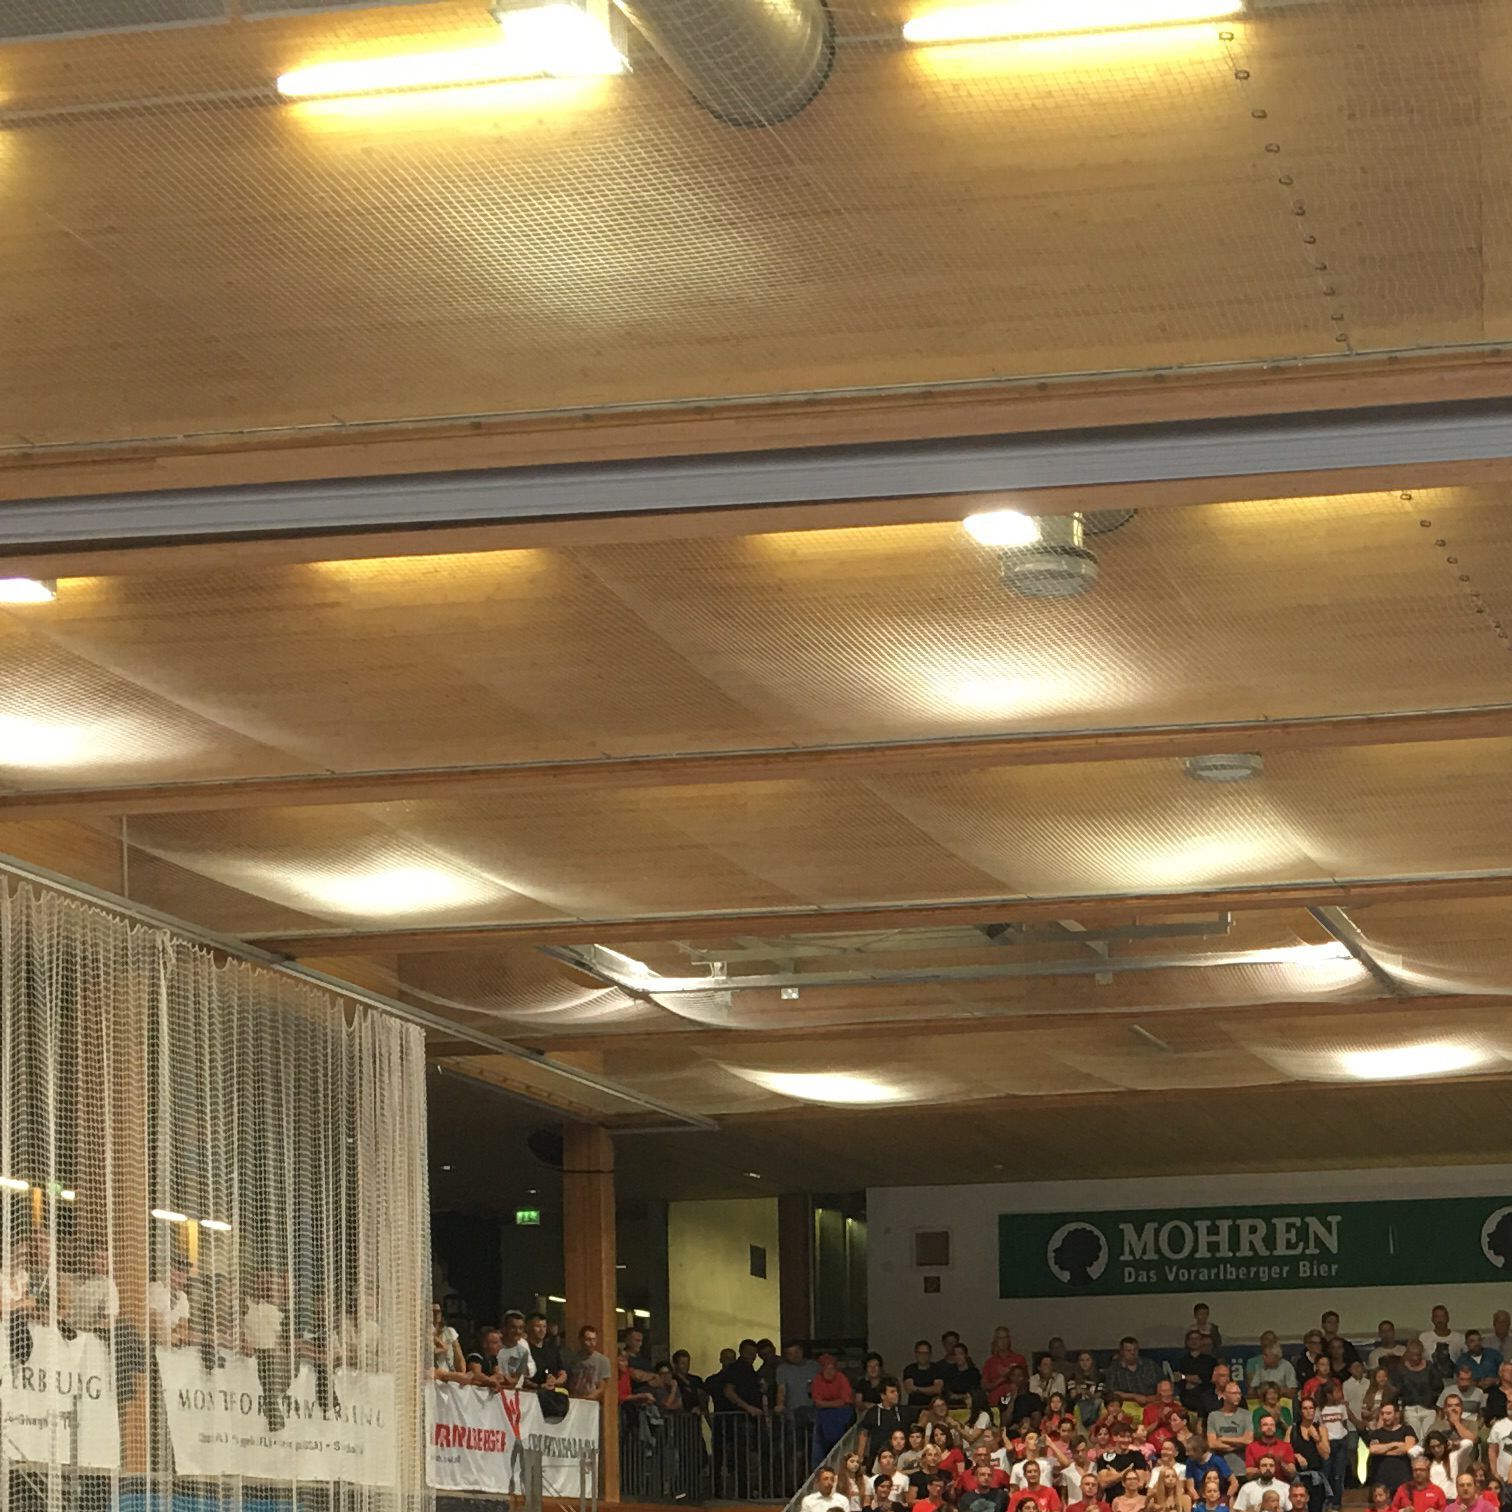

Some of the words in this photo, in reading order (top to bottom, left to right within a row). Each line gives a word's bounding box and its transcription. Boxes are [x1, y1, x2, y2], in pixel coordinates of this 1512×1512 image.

[1119, 1216, 1341, 1261] MOHREN
[1123, 1268, 1157, 1284] Das
[1164, 1262, 1290, 1283] Vorarlberger
[1299, 1261, 1339, 1277] Bier
